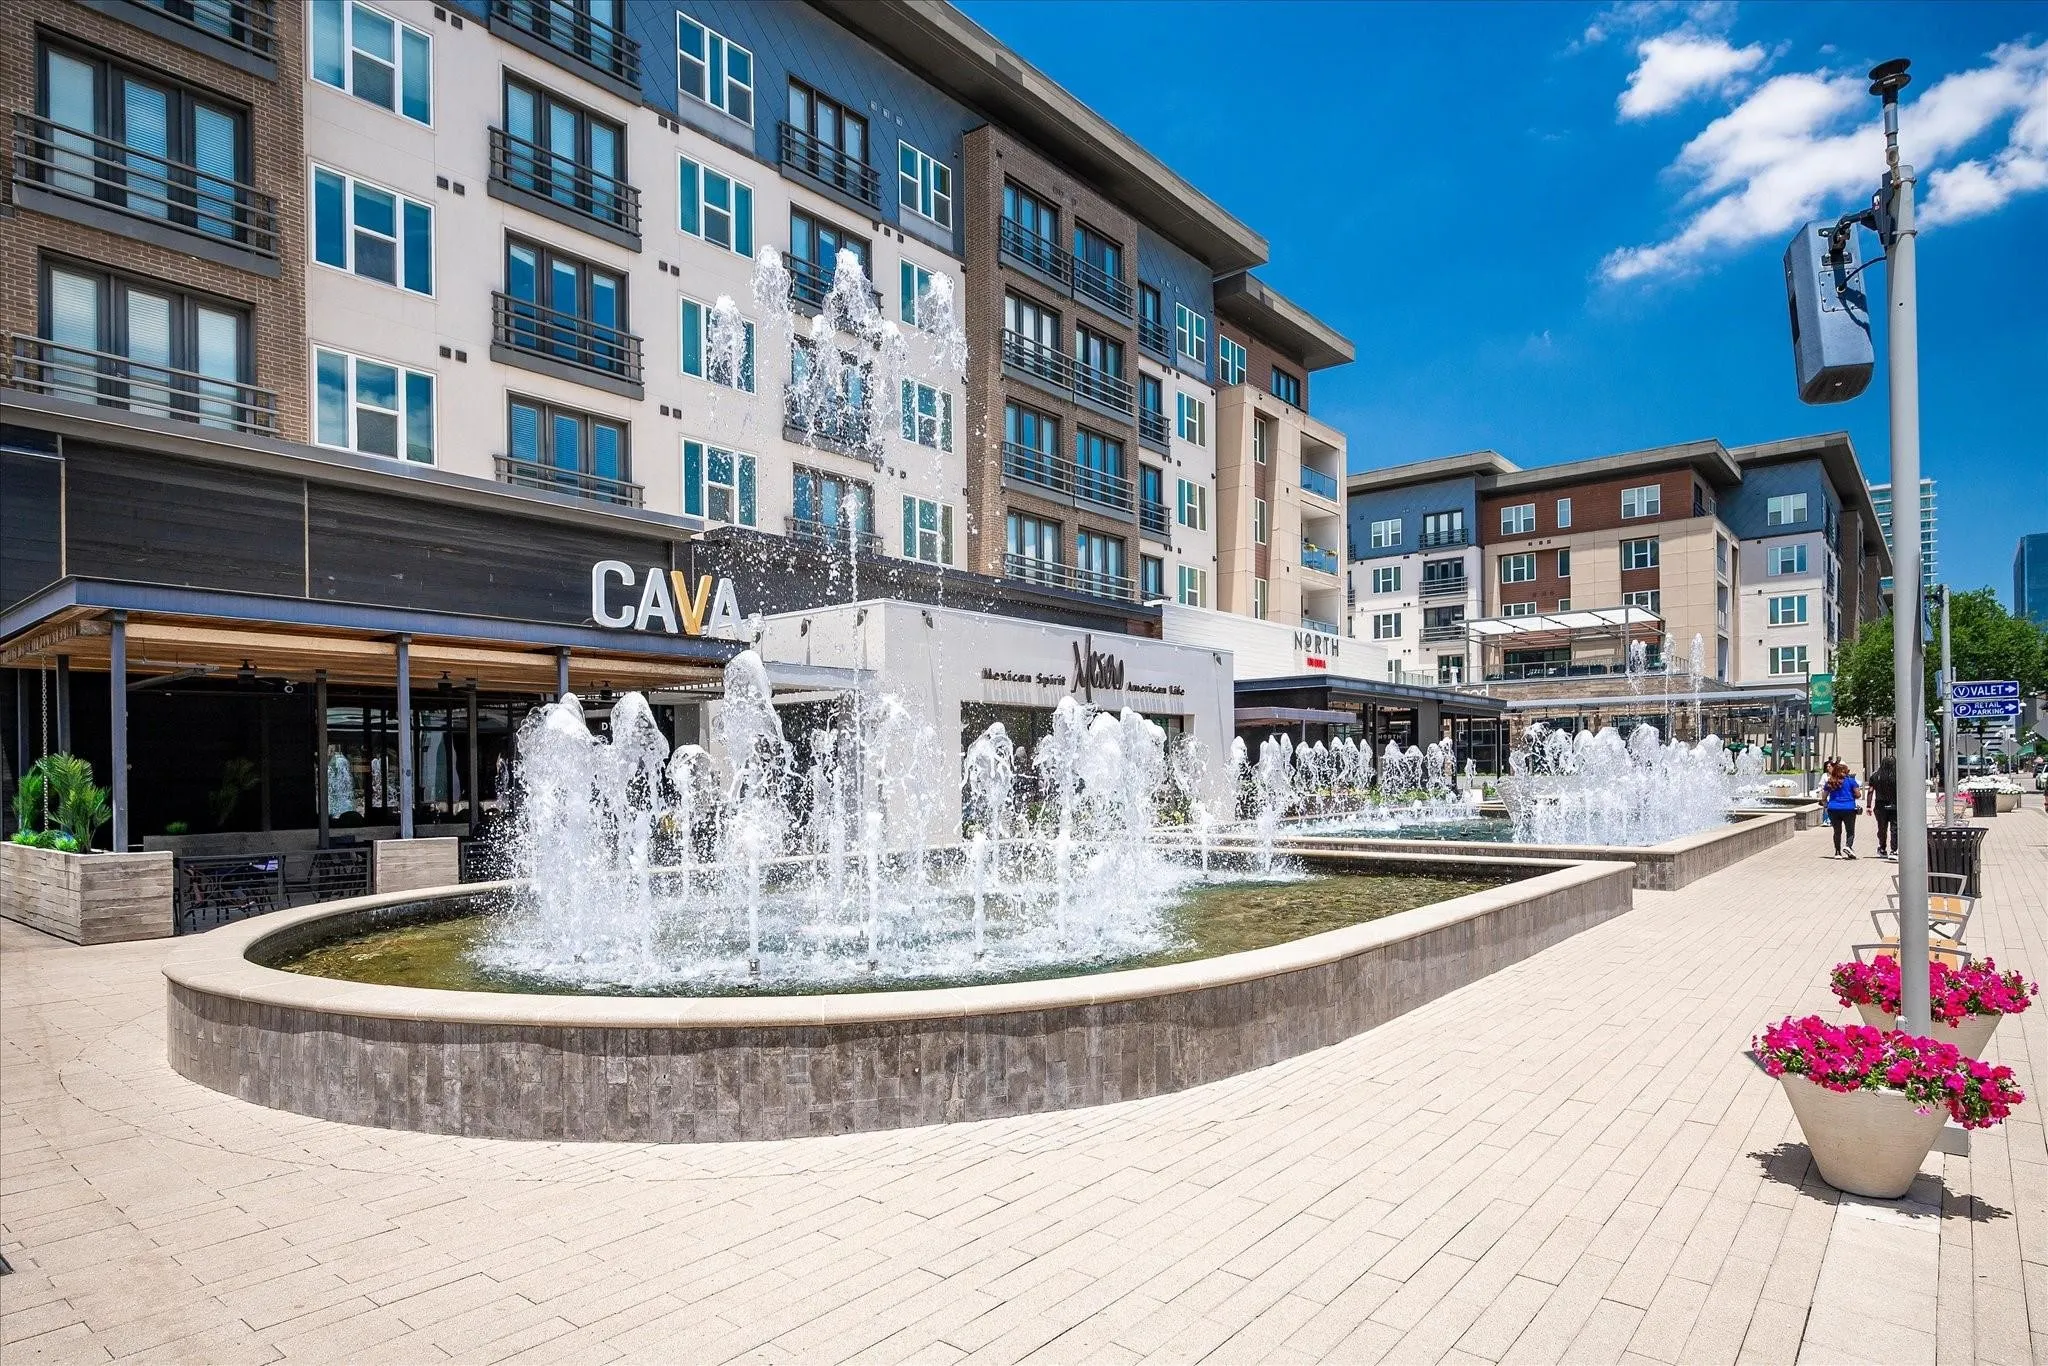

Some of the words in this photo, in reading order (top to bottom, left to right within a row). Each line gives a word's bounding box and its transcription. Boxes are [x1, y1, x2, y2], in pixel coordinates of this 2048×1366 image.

[592, 560, 745, 638] CAVA
[1294, 631, 1339, 657] NORTH
[982, 667, 1032, 683] Mexican
[1036, 673, 1066, 687] Spirit
[1127, 681, 1167, 694] American
[1169, 684, 1185, 696] Life
[1970, 685, 2004, 696] VALET
